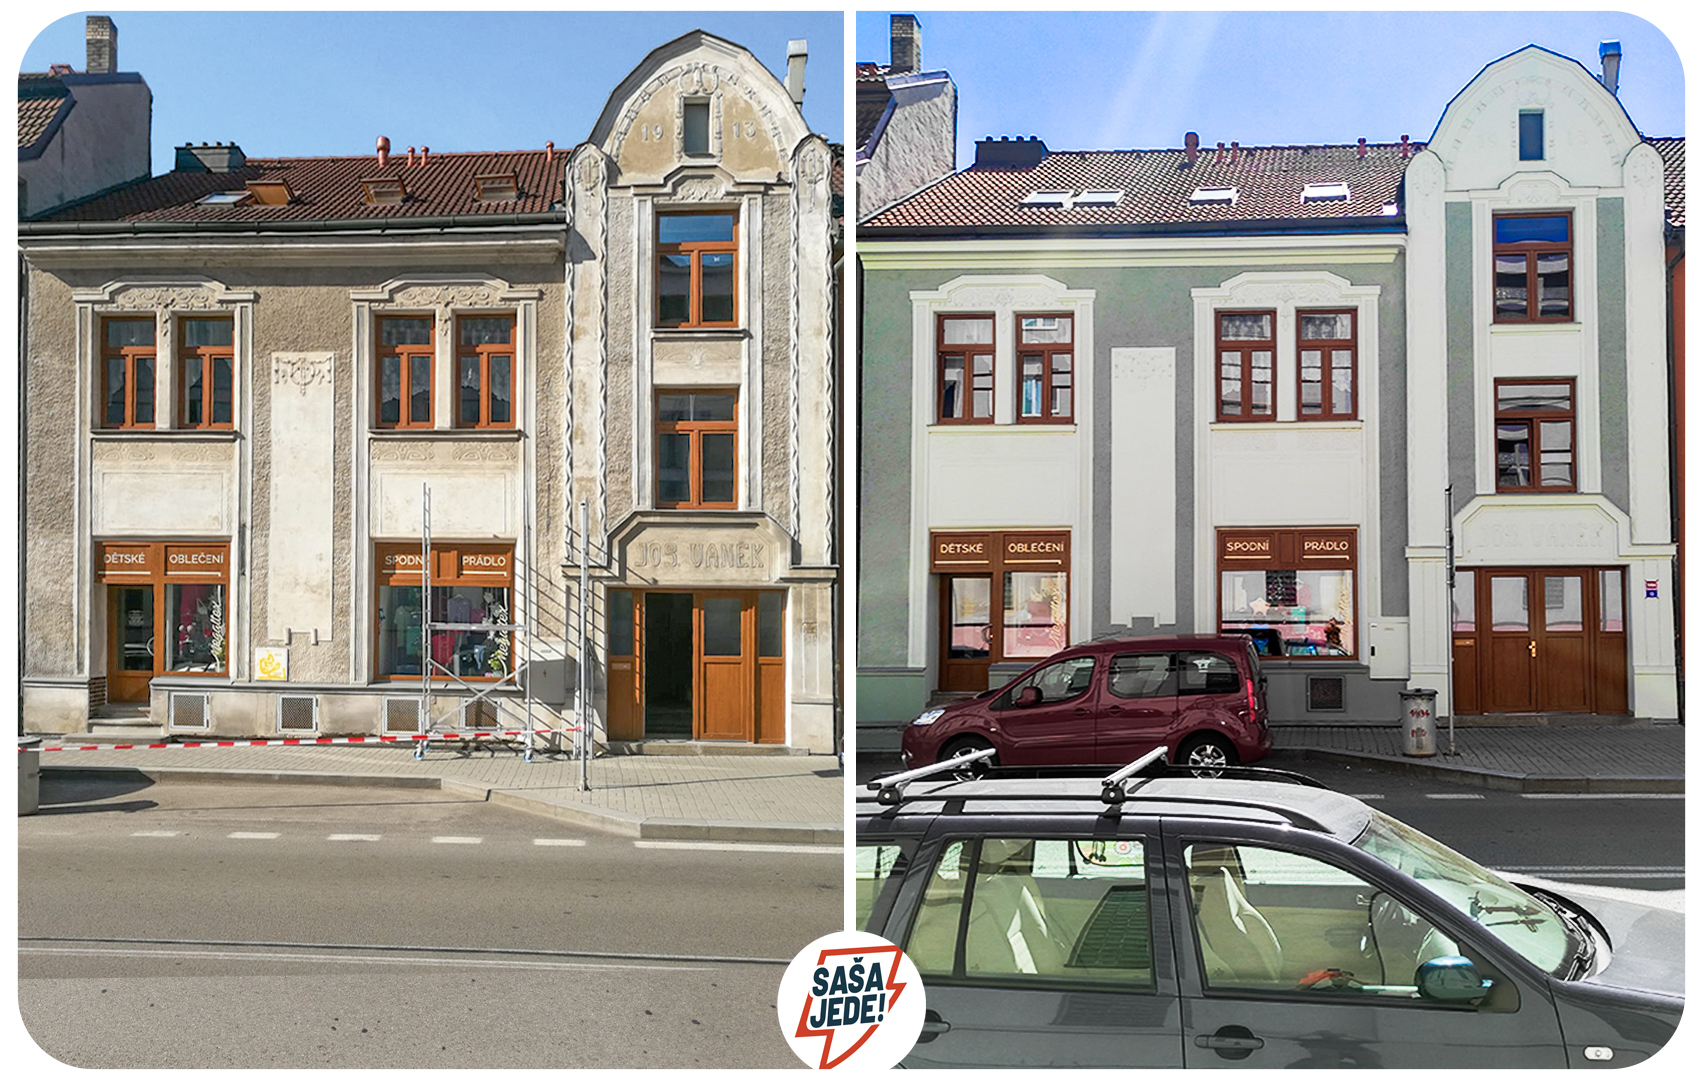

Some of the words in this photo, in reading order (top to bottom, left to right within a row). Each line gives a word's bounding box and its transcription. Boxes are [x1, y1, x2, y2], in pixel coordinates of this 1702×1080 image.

[641, 123, 664, 142] 19
[732, 121, 757, 139] 13
[940, 542, 984, 554] DĚTSKÉ
[1007, 541, 1065, 553] OBLEČENÍ
[1226, 539, 1269, 552] SPODNÍ
[1304, 539, 1349, 551] PRÁDLO
[103, 551, 146, 564] DĚTSKÉ
[168, 551, 225, 565] OBLEČENÍ
[385, 554, 425, 566] SPODN
[462, 553, 507, 567] PRÁDLO
